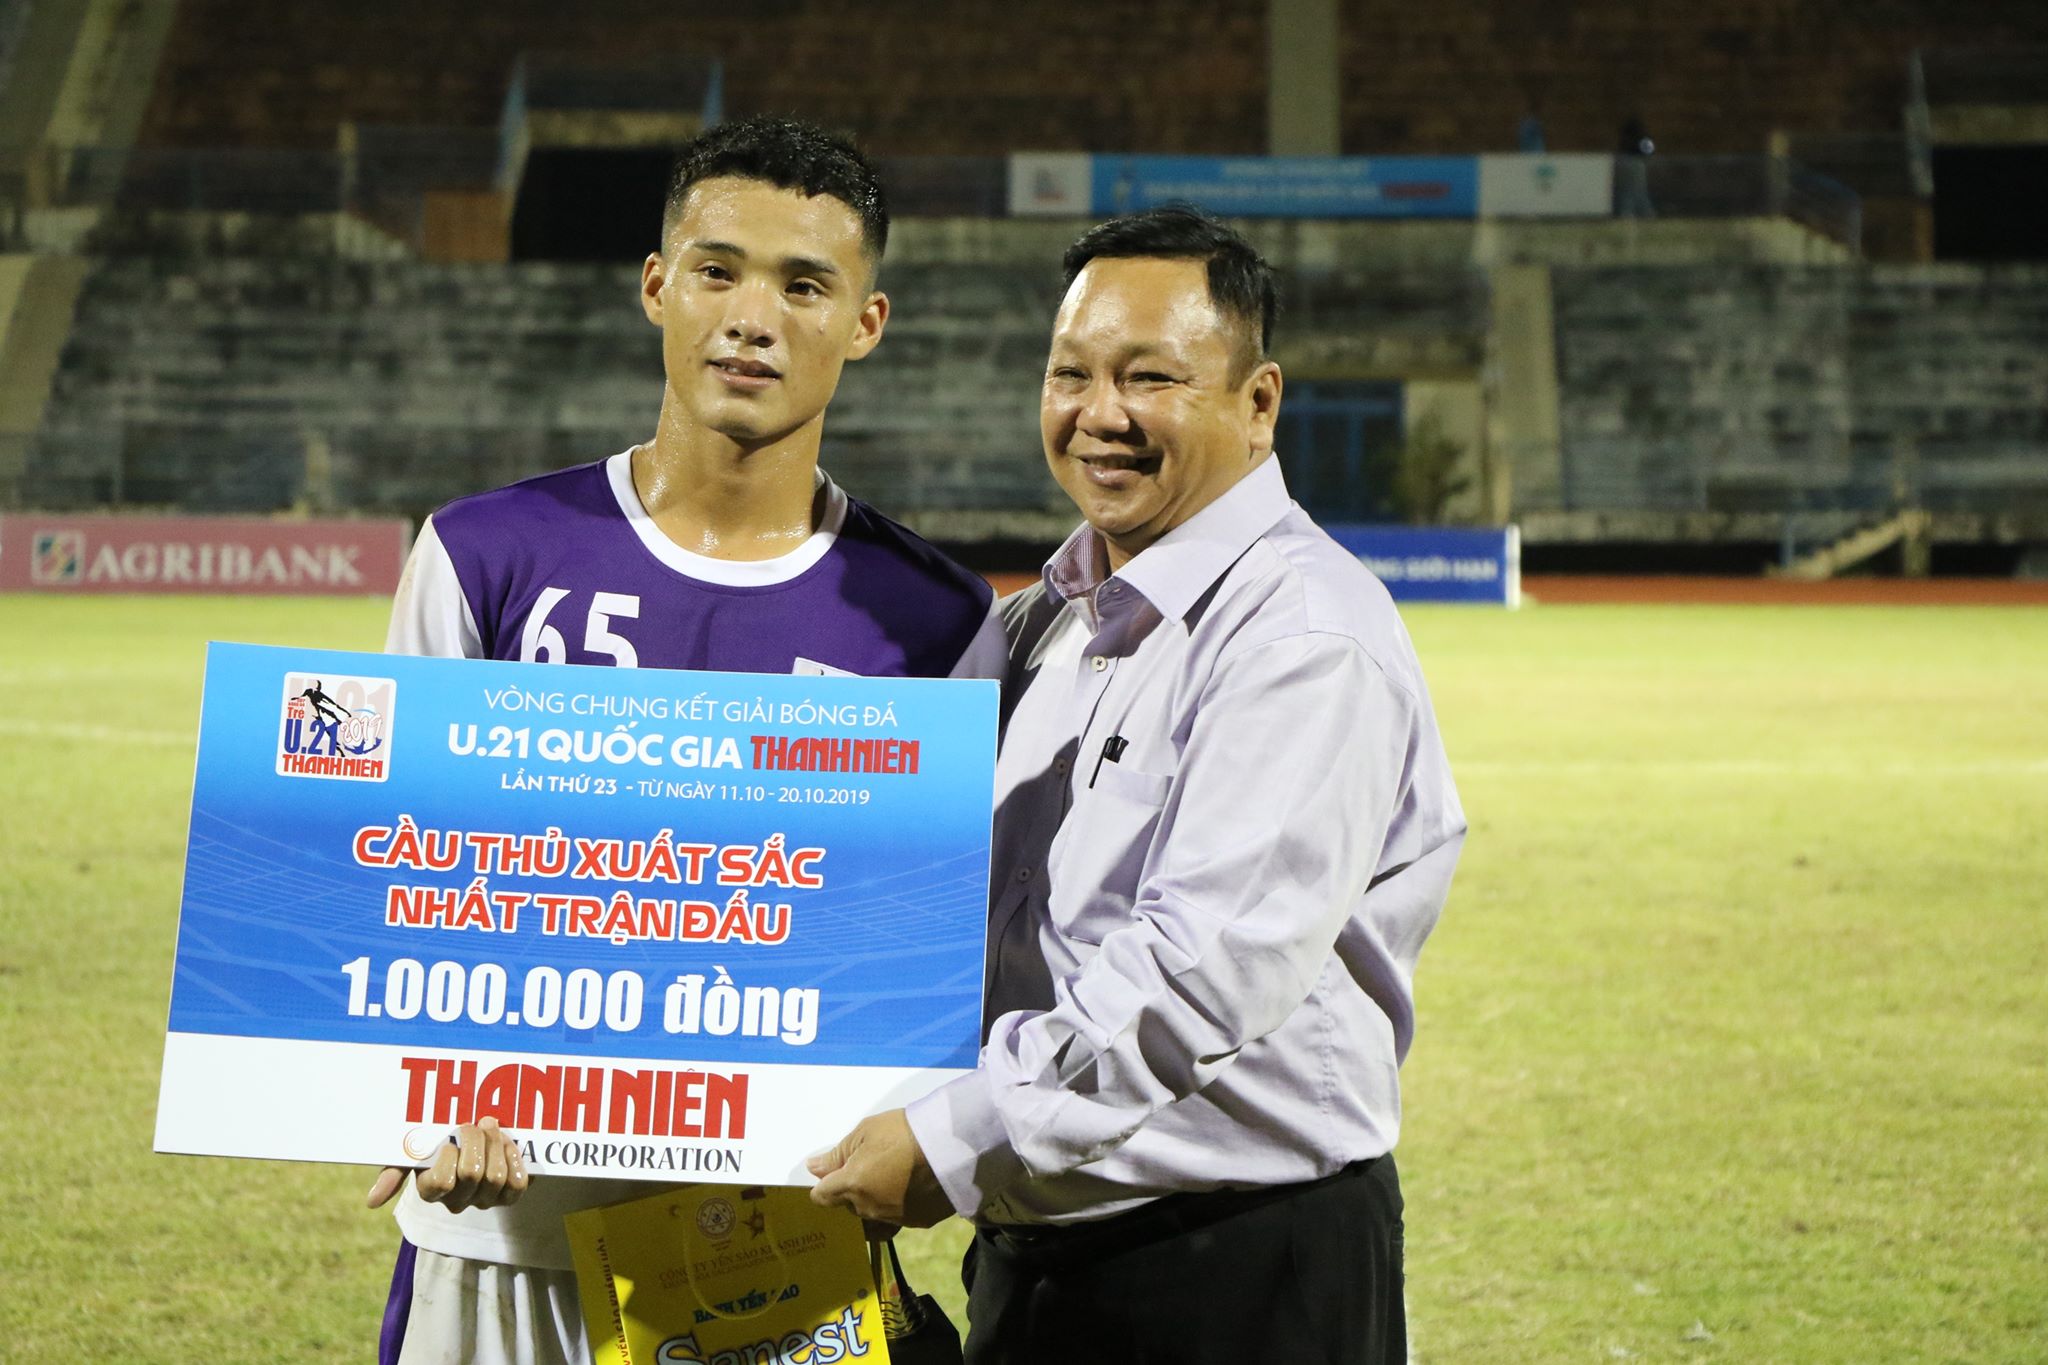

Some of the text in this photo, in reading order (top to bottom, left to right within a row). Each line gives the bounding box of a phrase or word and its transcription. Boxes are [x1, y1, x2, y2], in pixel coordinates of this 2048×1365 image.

[87, 542, 364, 585] AGRIBANK
[520, 586, 640, 668] 65
[484, 683, 898, 727] VÒNG CHUNG KẾT GIẢI BÓNG ĐÁ
[283, 717, 339, 757] U.21
[449, 723, 530, 759] U.21
[536, 720, 664, 767] QUỐC
[670, 735, 744, 770] GIA
[500, 766, 543, 791] LẦN
[547, 773, 591, 794] THỨ
[593, 778, 617, 795] 23
[637, 778, 663, 798] TỪ
[666, 779, 716, 800] NGÀY
[720, 785, 765, 802] 11.10
[778, 786, 871, 805] 20.10.2019
[353, 814, 827, 889] CẦU THỦ XUẤT SẮC
[384, 877, 792, 946] NHẤT TRẬN ĐẤU
[341, 956, 820, 1046] 1.000.000 đồng
[545, 1140, 743, 1173] CORPORATION
